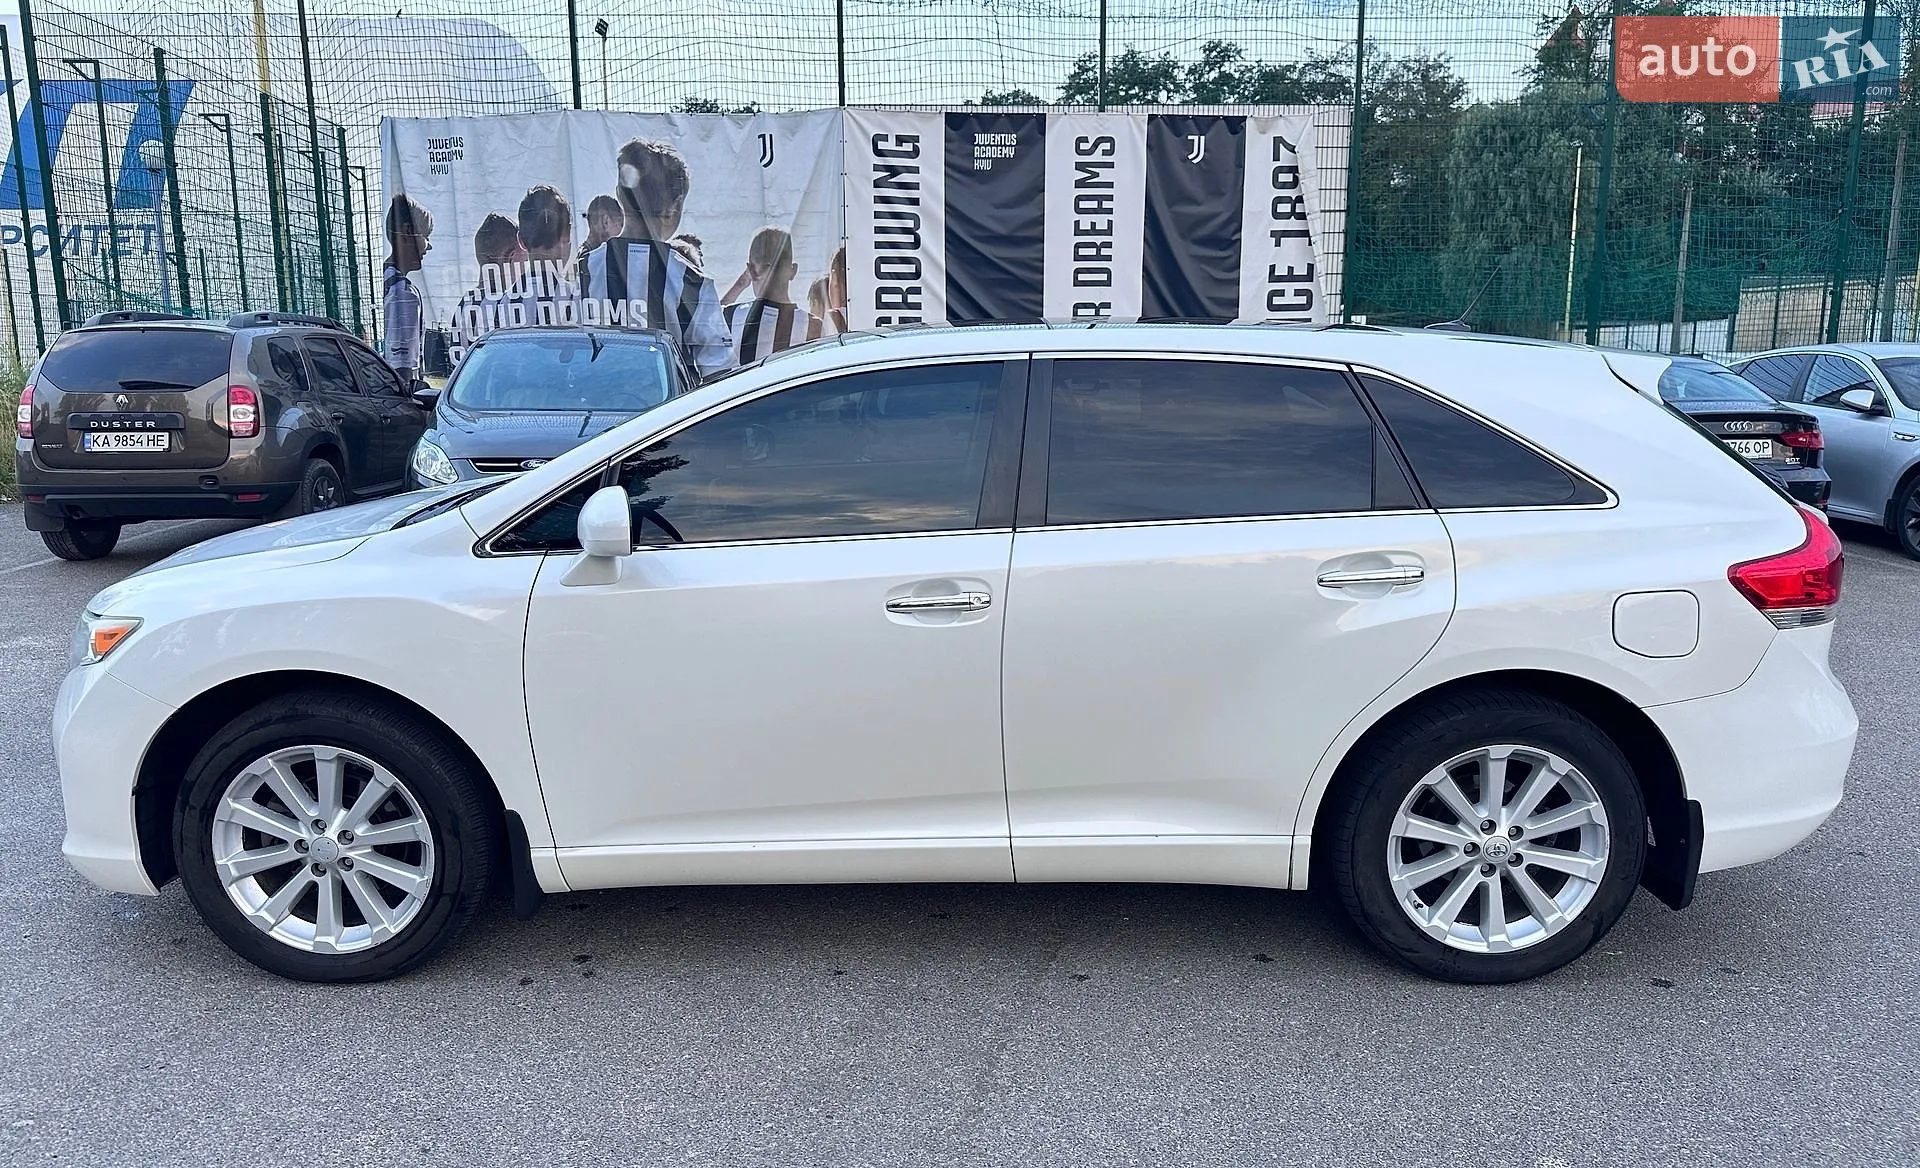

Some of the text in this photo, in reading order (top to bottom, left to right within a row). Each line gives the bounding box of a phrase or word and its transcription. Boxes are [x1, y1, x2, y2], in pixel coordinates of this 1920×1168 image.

[974, 133, 1017, 145] JUVENTUS
[974, 146, 1015, 158] ACADEMY
[974, 159, 992, 170] KYIV
[1270, 136, 1313, 247] 1897
[1073, 136, 1116, 288] DREAMS
[92, 435, 165, 447] KA 9854 HE
[1753, 441, 1770, 453] OP
